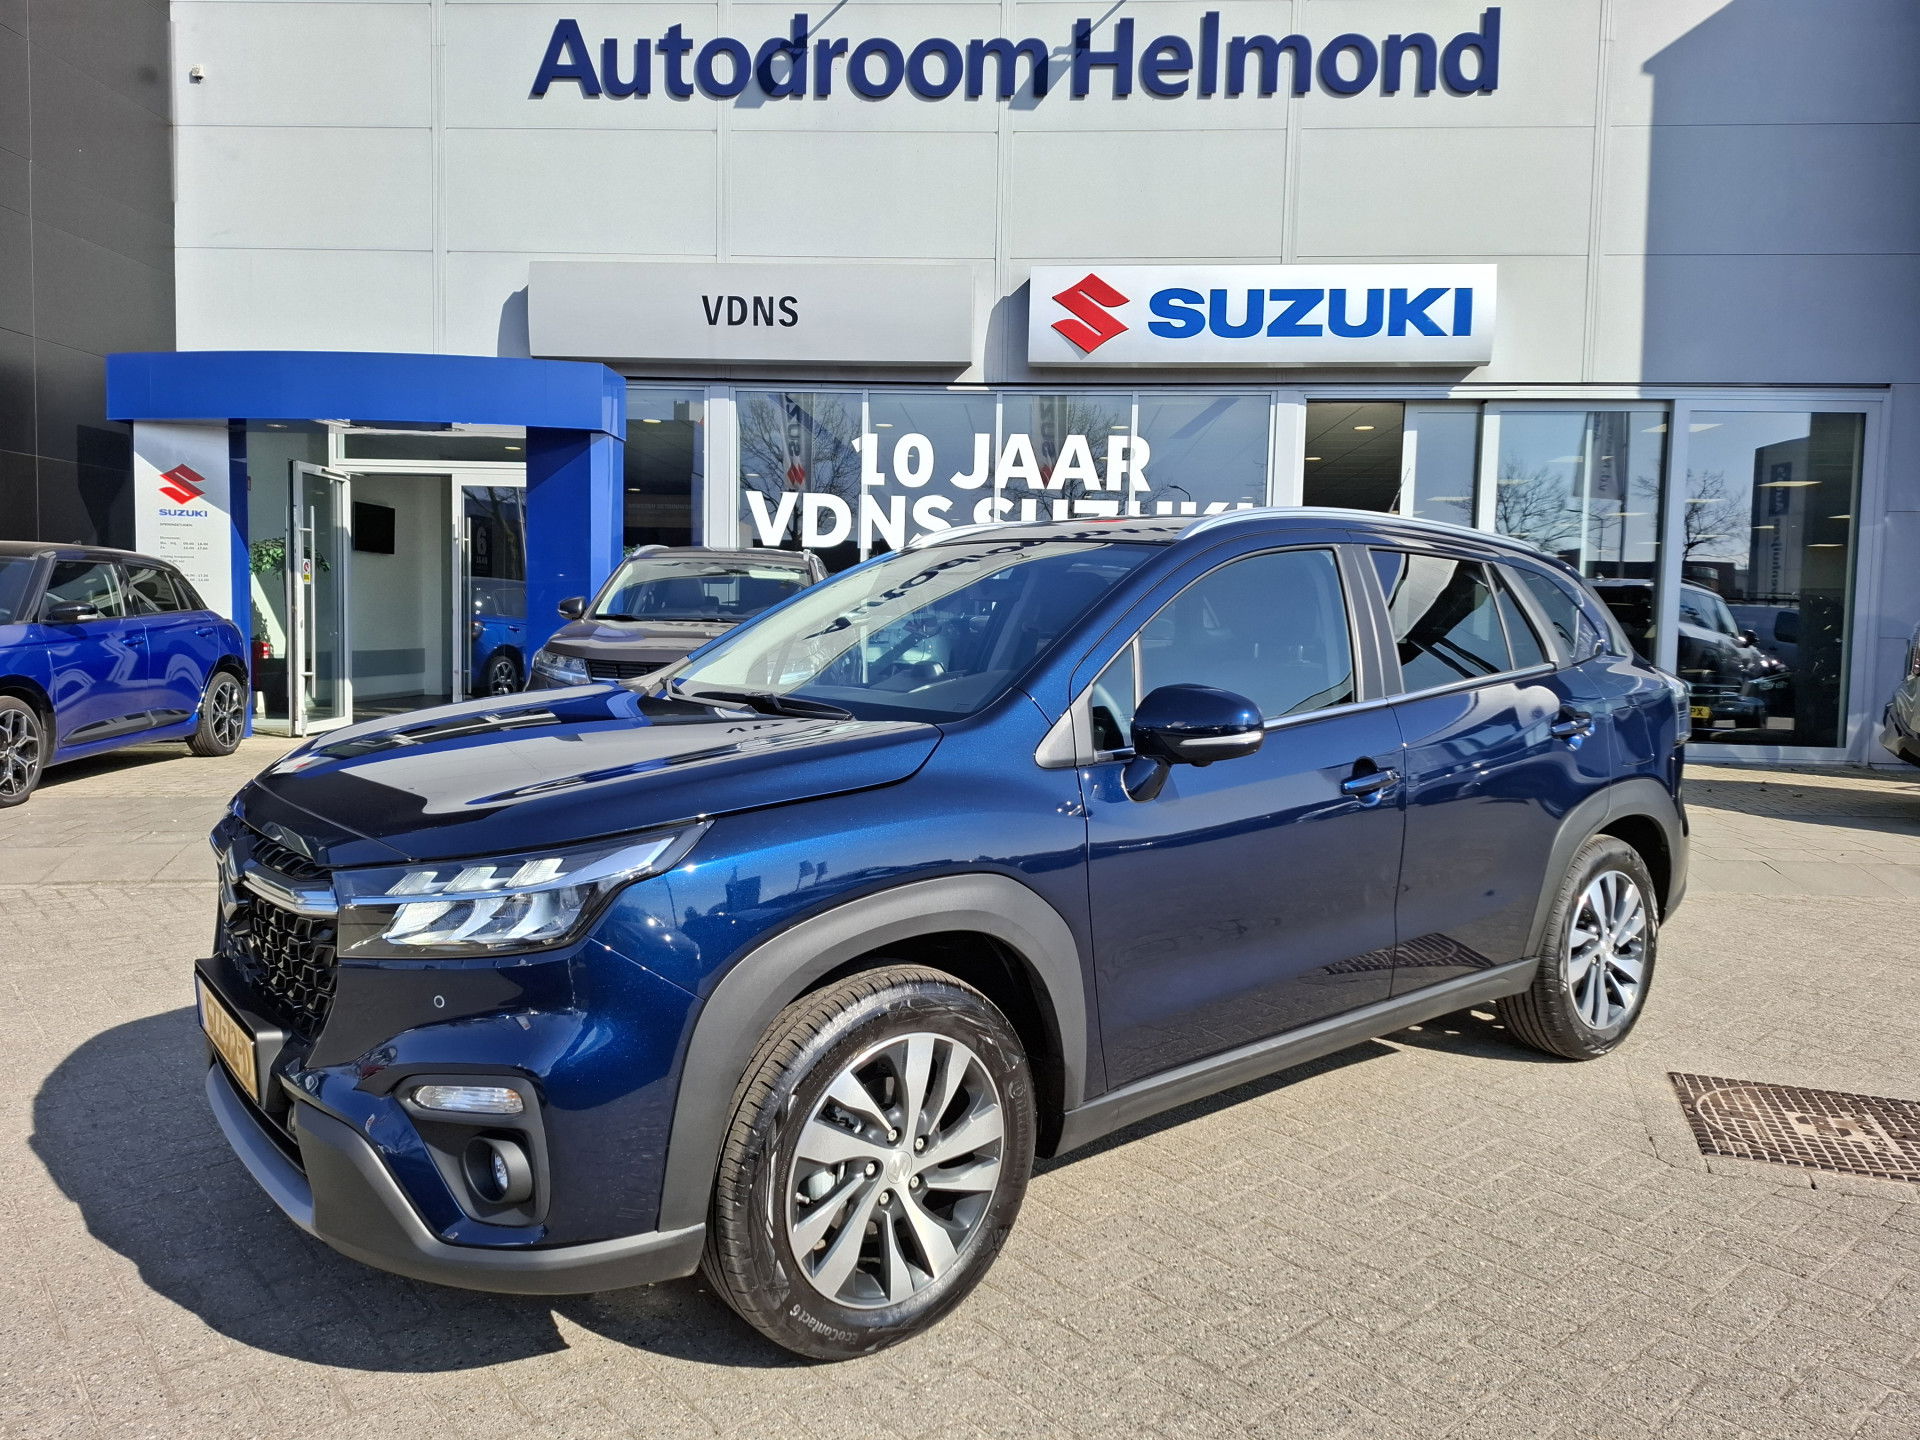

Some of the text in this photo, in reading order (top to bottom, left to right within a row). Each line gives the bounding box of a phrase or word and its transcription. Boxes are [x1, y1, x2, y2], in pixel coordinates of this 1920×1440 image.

[531, 7, 1502, 98] Autodroom Helmond
[701, 295, 799, 328] VDNS
[1148, 287, 1474, 339] SUZUKI
[851, 433, 1152, 492] 10 JAAR
[159, 508, 208, 518] SUZUKI
[746, 490, 954, 551] VDNS
[789, 1303, 859, 1345] EcoContact 6
